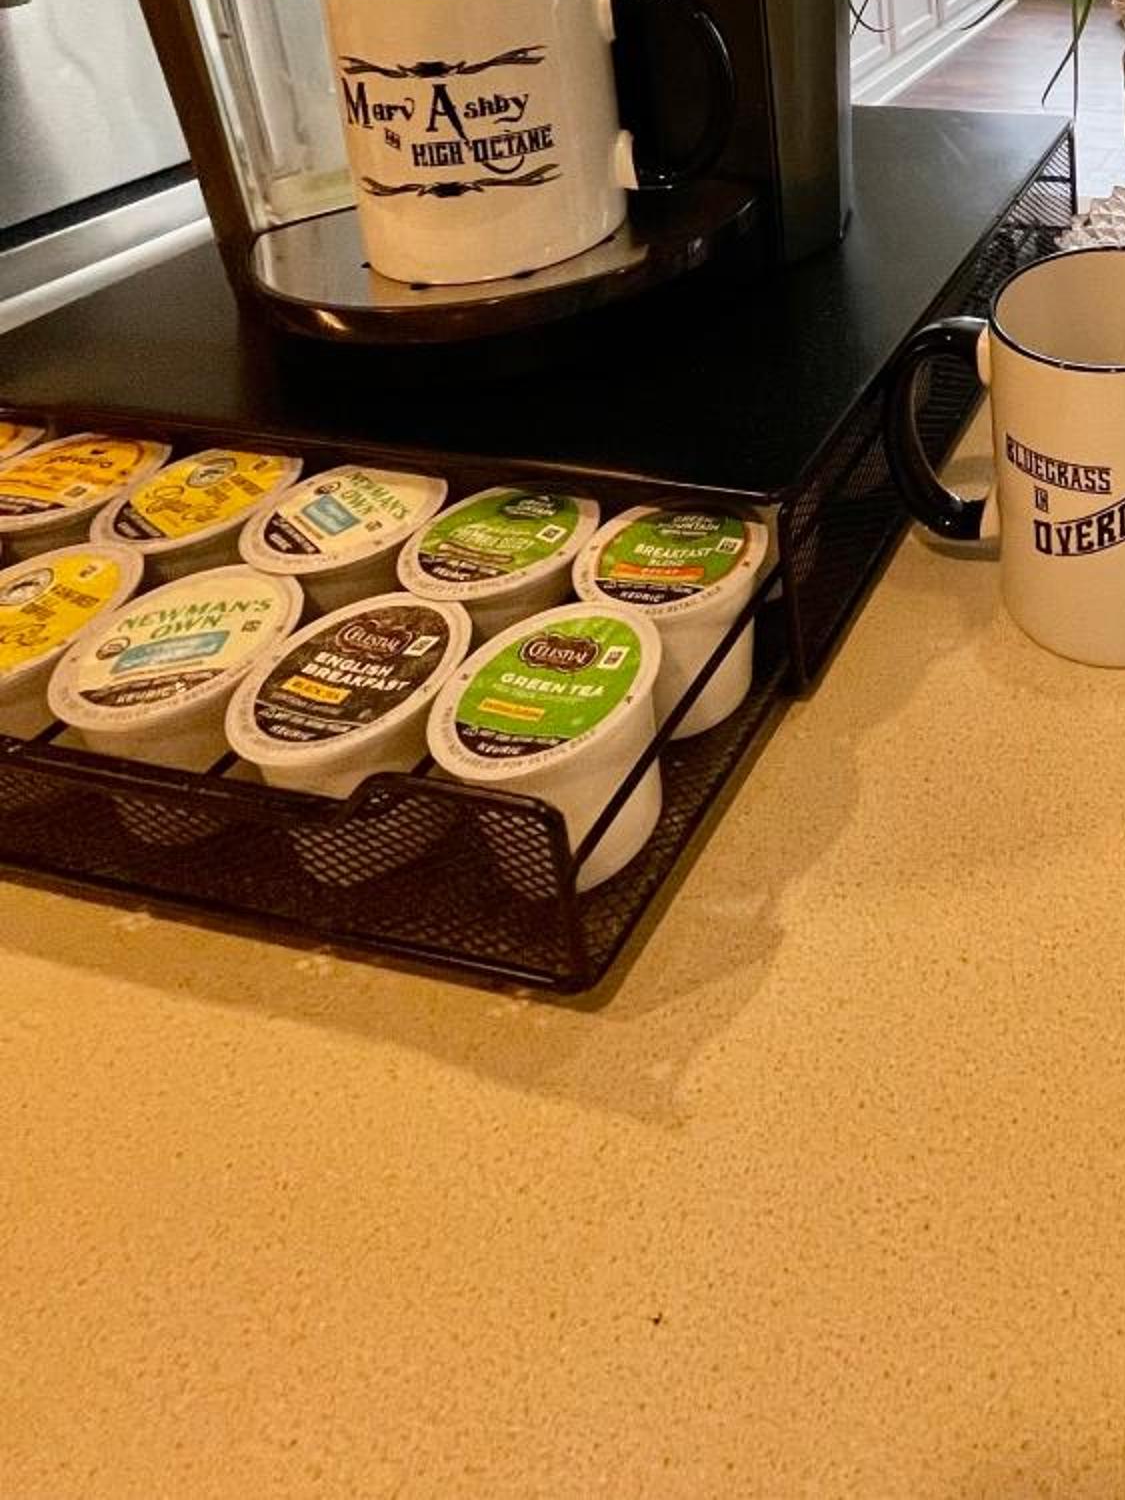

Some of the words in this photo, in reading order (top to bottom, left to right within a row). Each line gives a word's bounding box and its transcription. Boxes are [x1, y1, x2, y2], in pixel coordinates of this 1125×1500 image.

[426, 84, 529, 143] Ashby
[412, 141, 466, 167] HIGH
[466, 124, 555, 168] OCTANE
[1006, 432, 1111, 495] BLUEGRASS
[633, 544, 714, 558] BREAKFAST
[117, 598, 273, 632] NEWMAN'S
[150, 614, 223, 639] OWN
[301, 663, 411, 691] BREAKFAST
[314, 652, 395, 677] ENGLISH
[501, 672, 568, 694] GREEN
[569, 684, 607, 697] TEA
